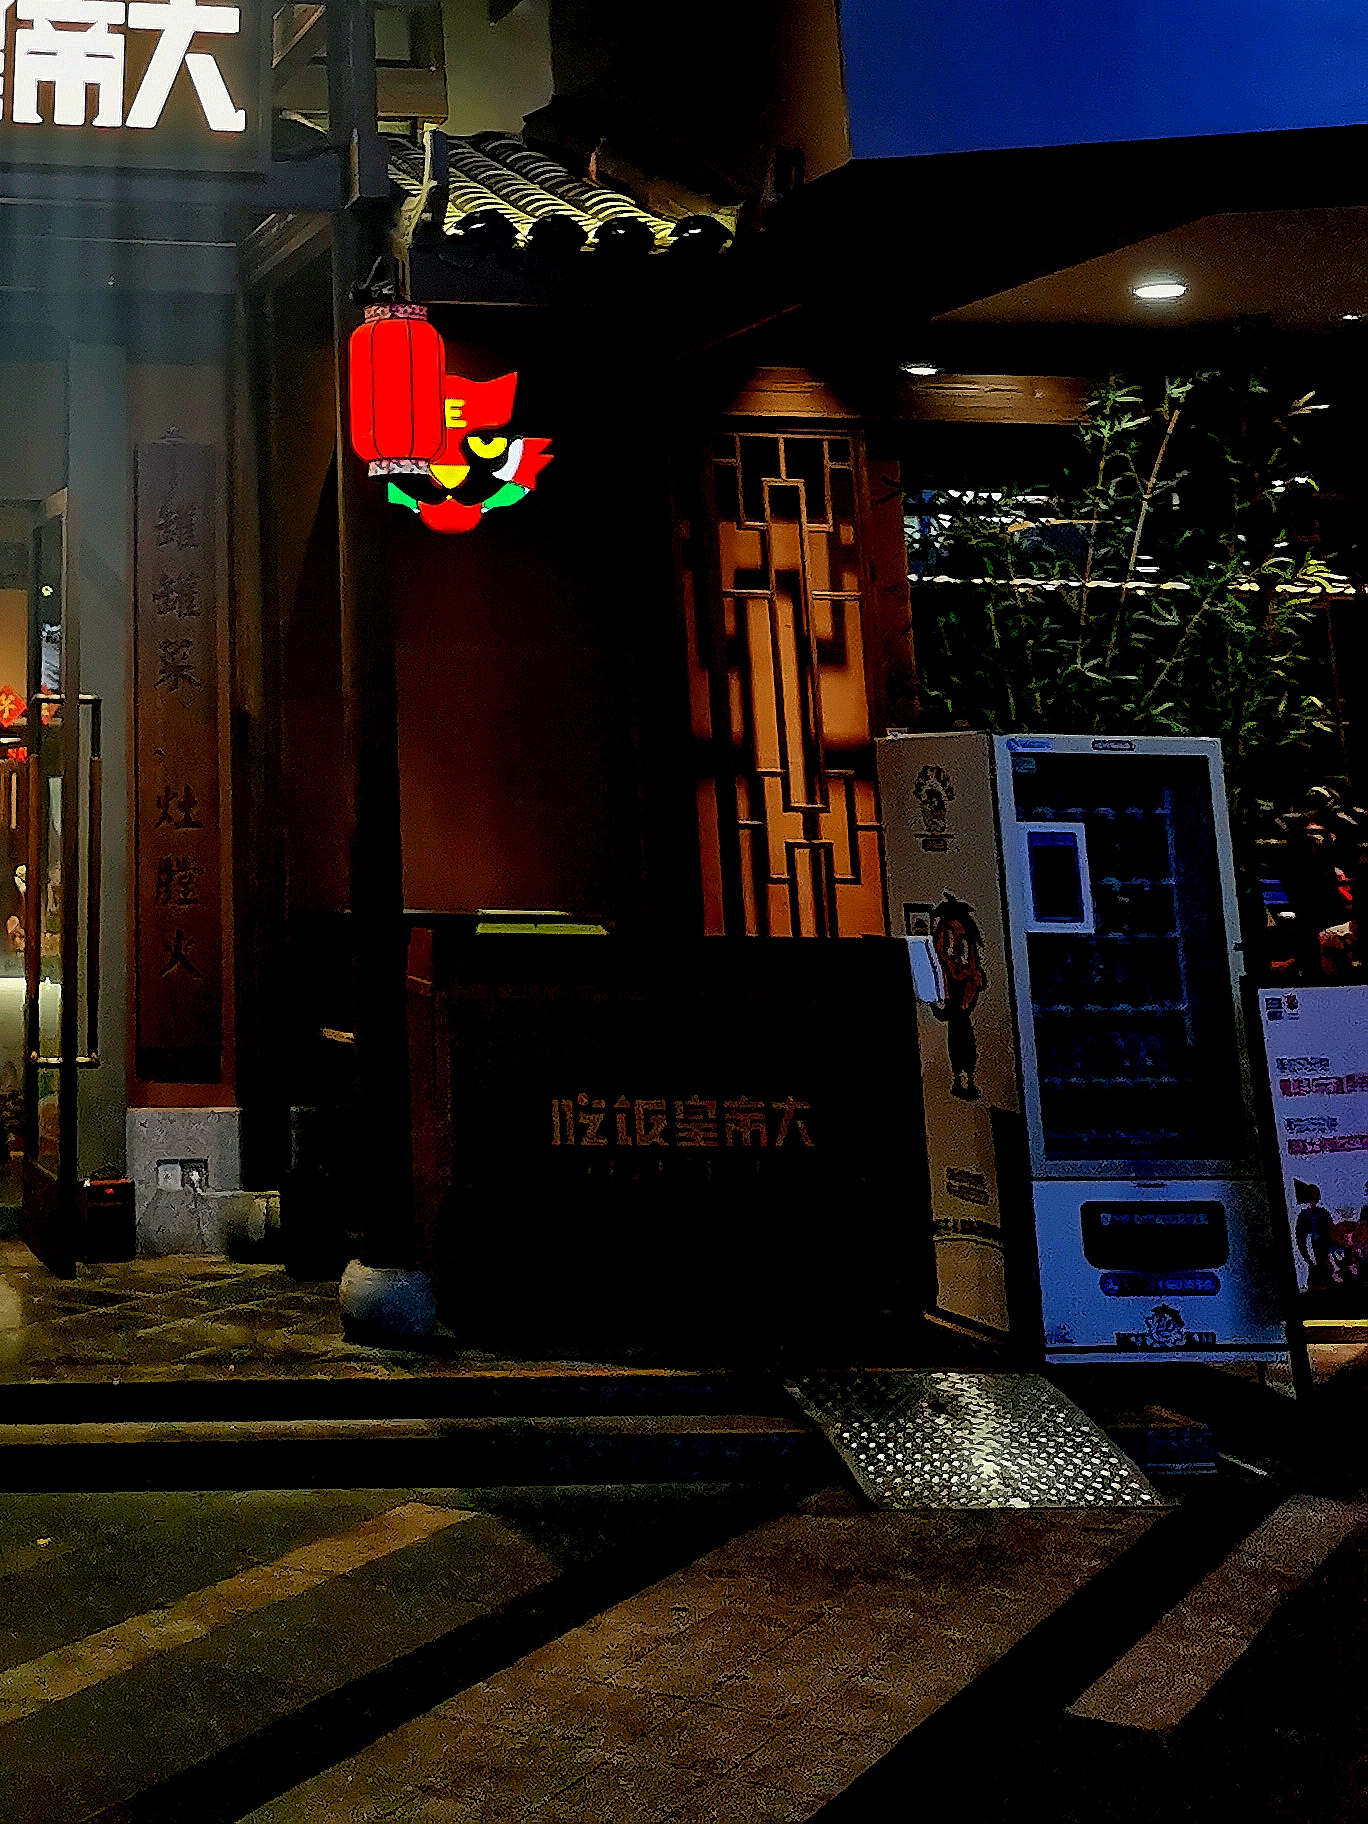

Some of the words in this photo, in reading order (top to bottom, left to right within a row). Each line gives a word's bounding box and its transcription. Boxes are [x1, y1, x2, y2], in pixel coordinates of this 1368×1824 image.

[550, 1092, 815, 1148] 吃饭皇帝大
